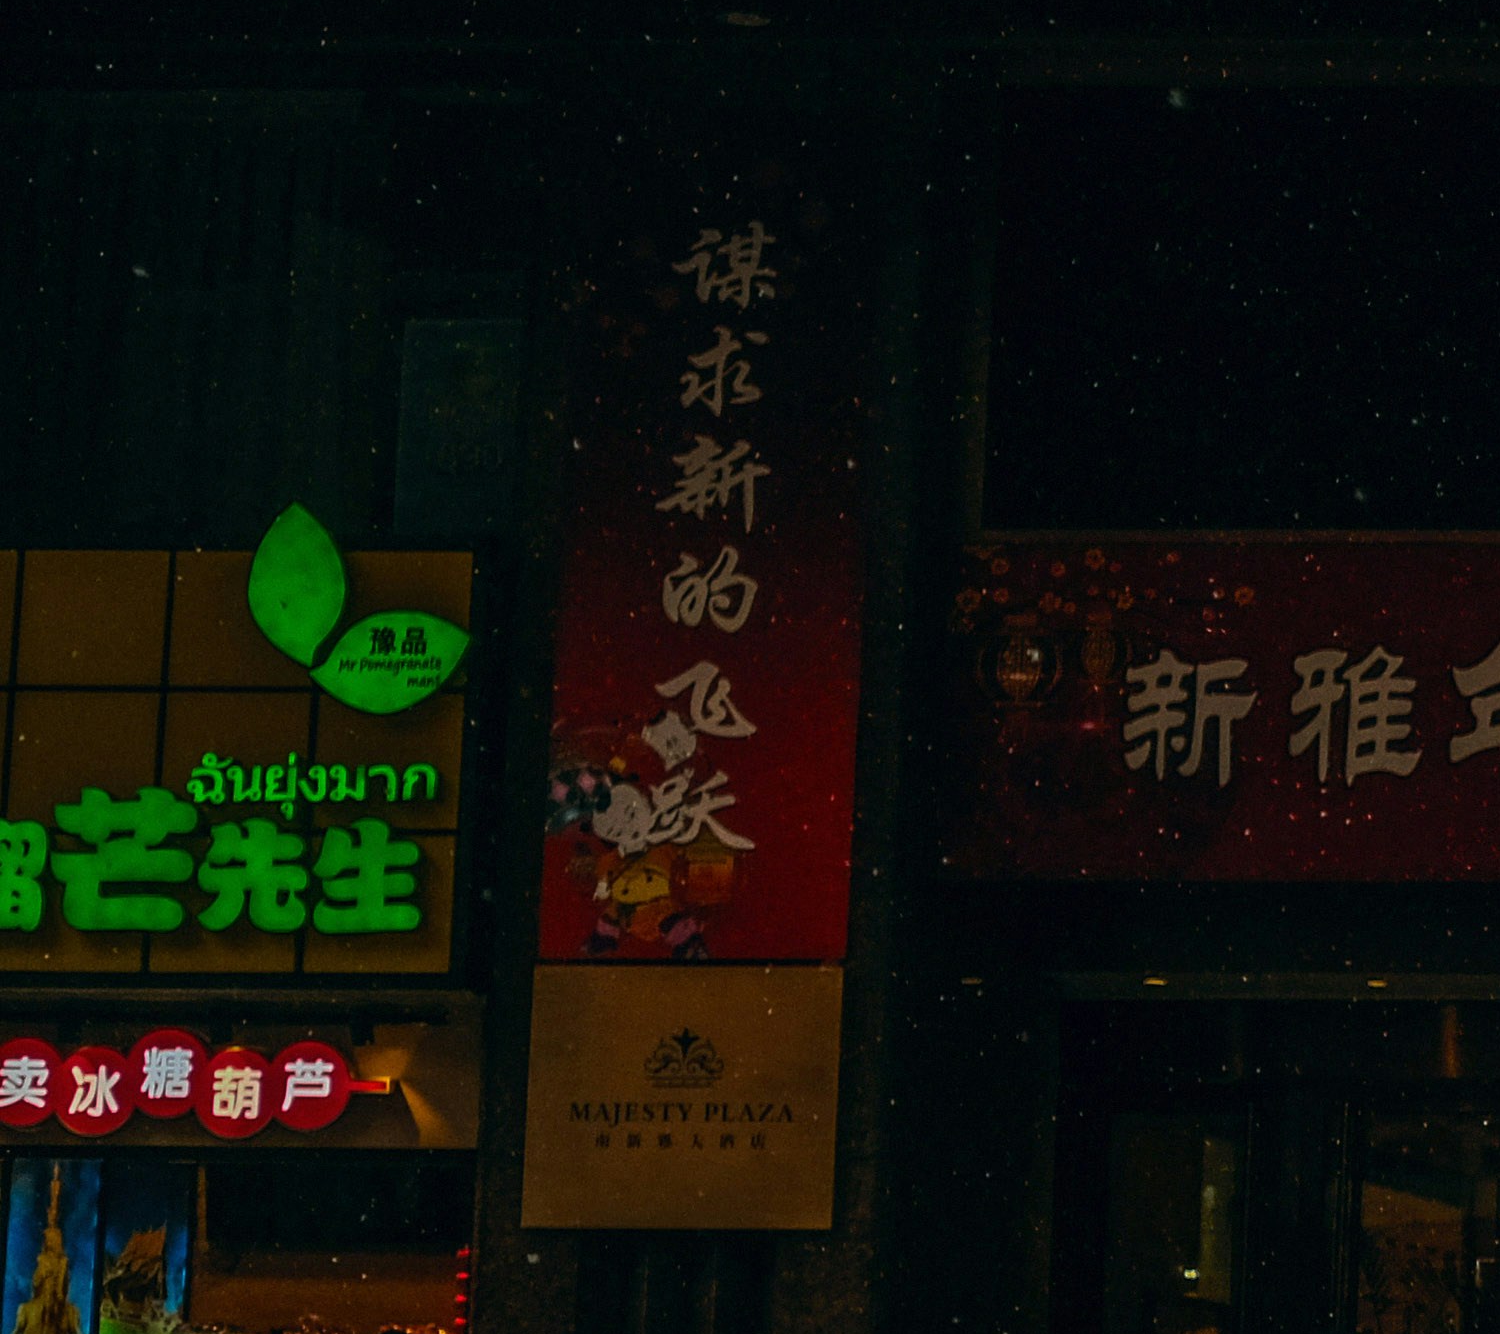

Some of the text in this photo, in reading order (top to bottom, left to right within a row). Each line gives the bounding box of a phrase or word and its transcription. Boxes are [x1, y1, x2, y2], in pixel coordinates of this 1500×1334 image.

[655, 221, 778, 851] 谋求新的飞跃
[186, 751, 439, 821] ฉันยุ่งมาก
[0, 1046, 336, 1120] 卖冰糖葫芦
[569, 1102, 794, 1127] MAJESTY PLAZA
